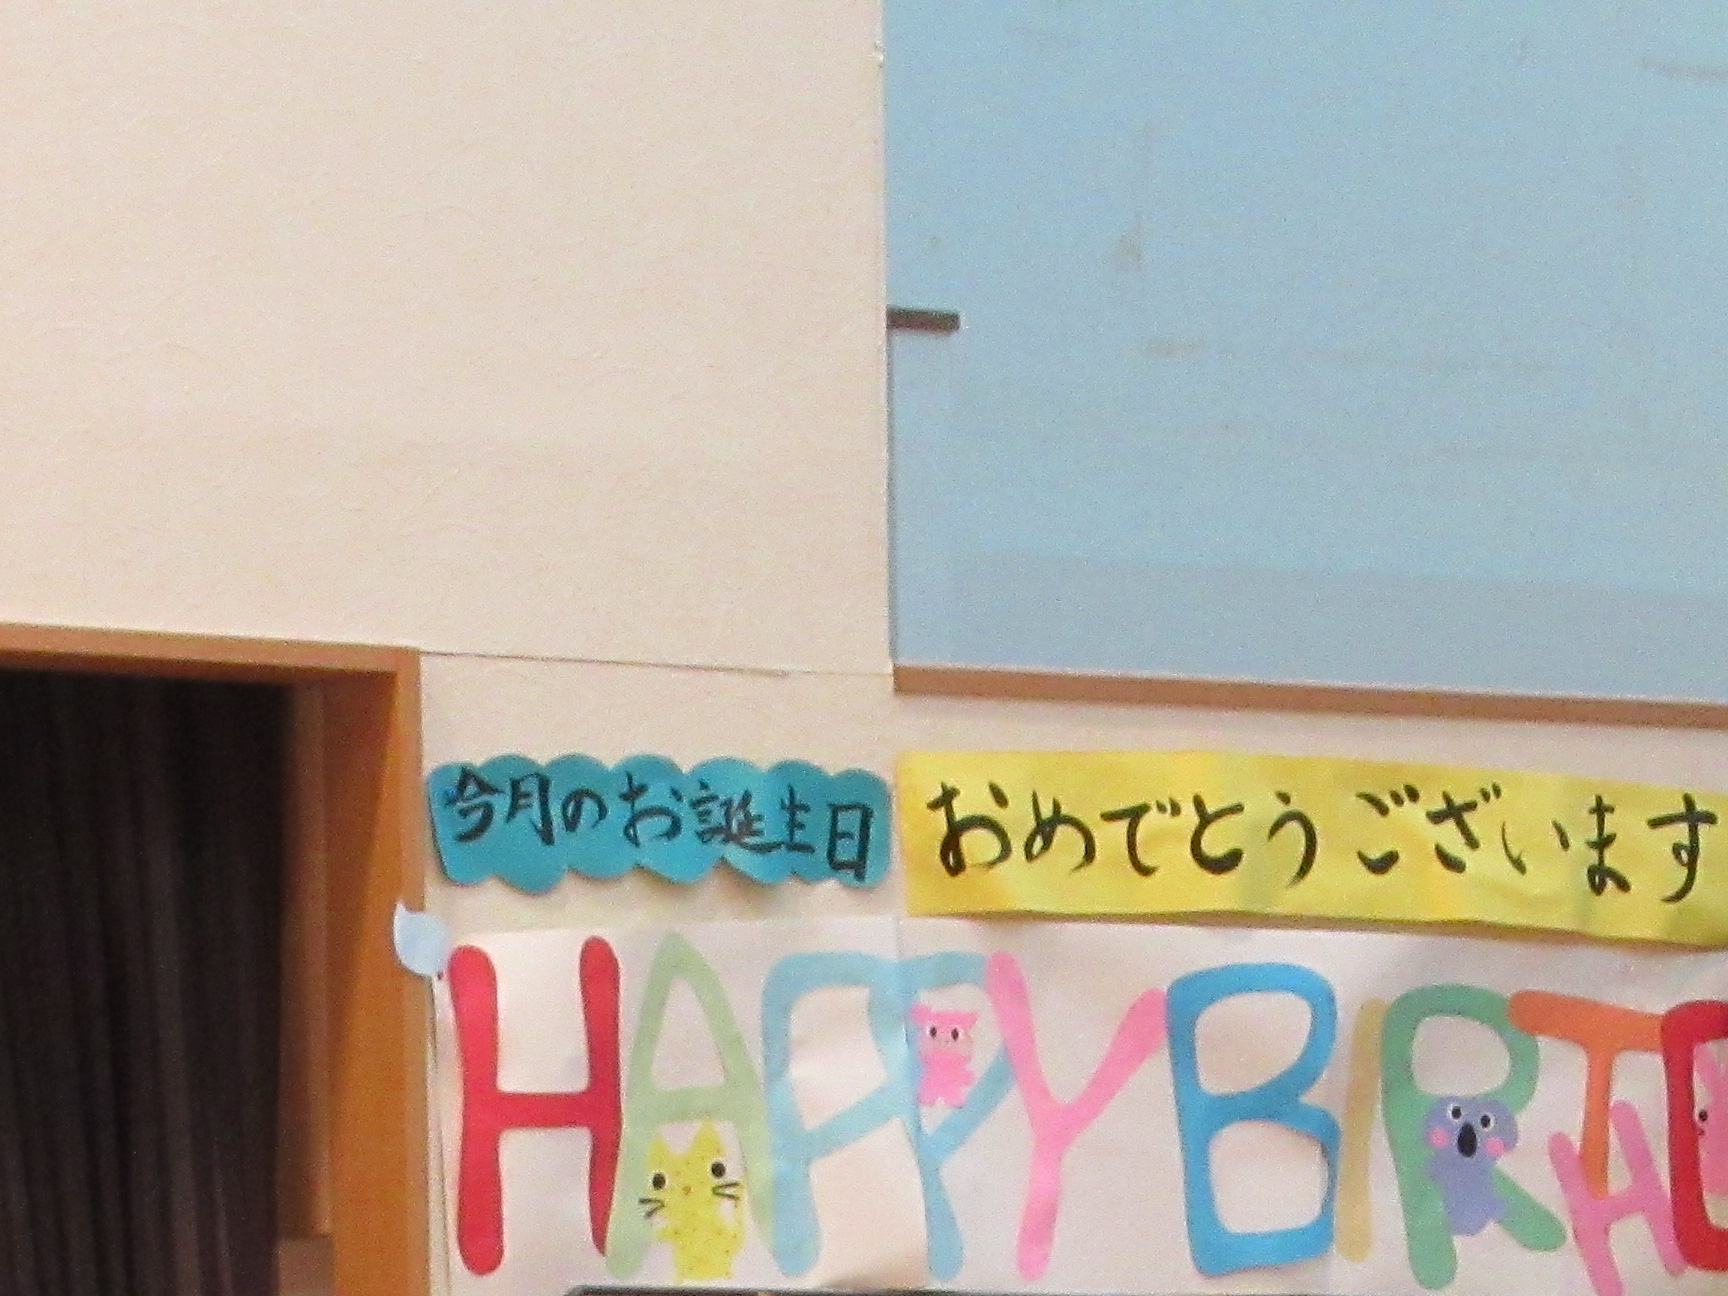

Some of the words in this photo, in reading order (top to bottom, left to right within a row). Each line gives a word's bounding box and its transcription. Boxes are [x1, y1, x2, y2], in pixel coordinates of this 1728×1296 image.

[445, 767, 873, 881] 今月のお誕生日
[928, 781, 1719, 904] おめでとうございます
[449, 932, 1169, 1280] HAPPY
